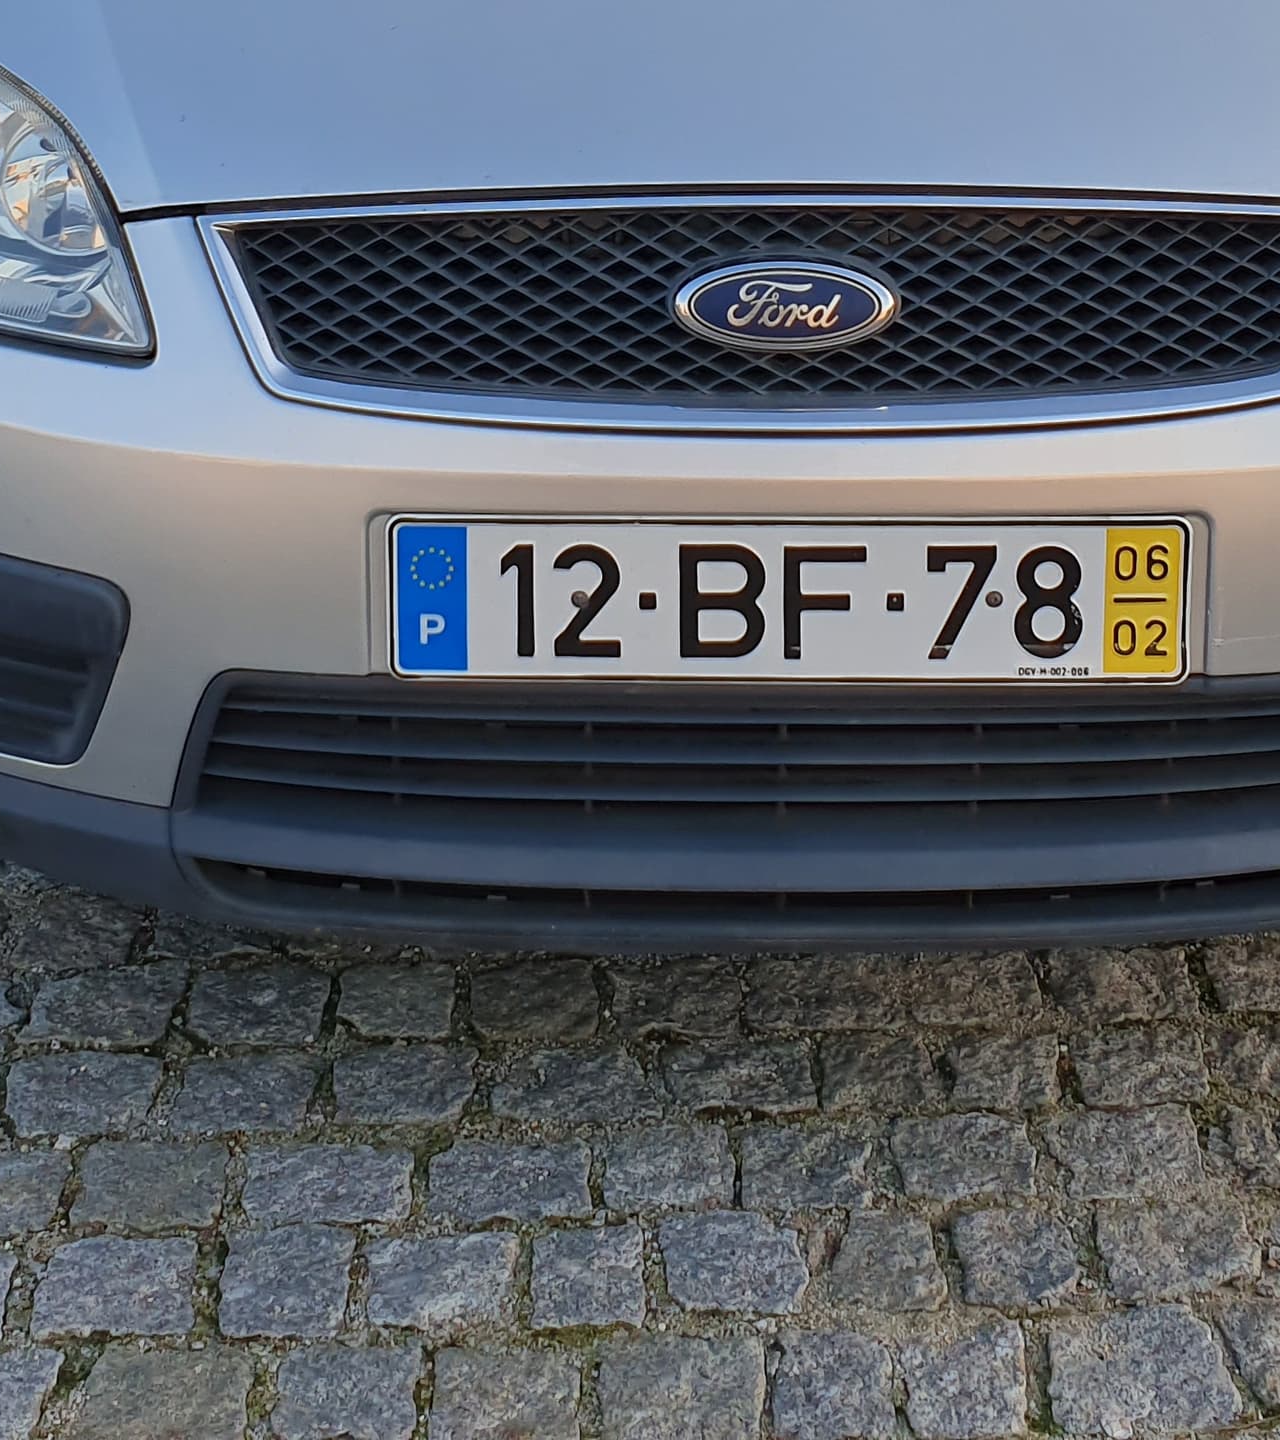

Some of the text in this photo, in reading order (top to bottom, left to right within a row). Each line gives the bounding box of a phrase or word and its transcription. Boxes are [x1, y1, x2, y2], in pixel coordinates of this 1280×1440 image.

[726, 279, 843, 329] Ford
[1113, 543, 1170, 582] 06
[419, 612, 447, 646] P
[1111, 618, 1169, 657] 02
